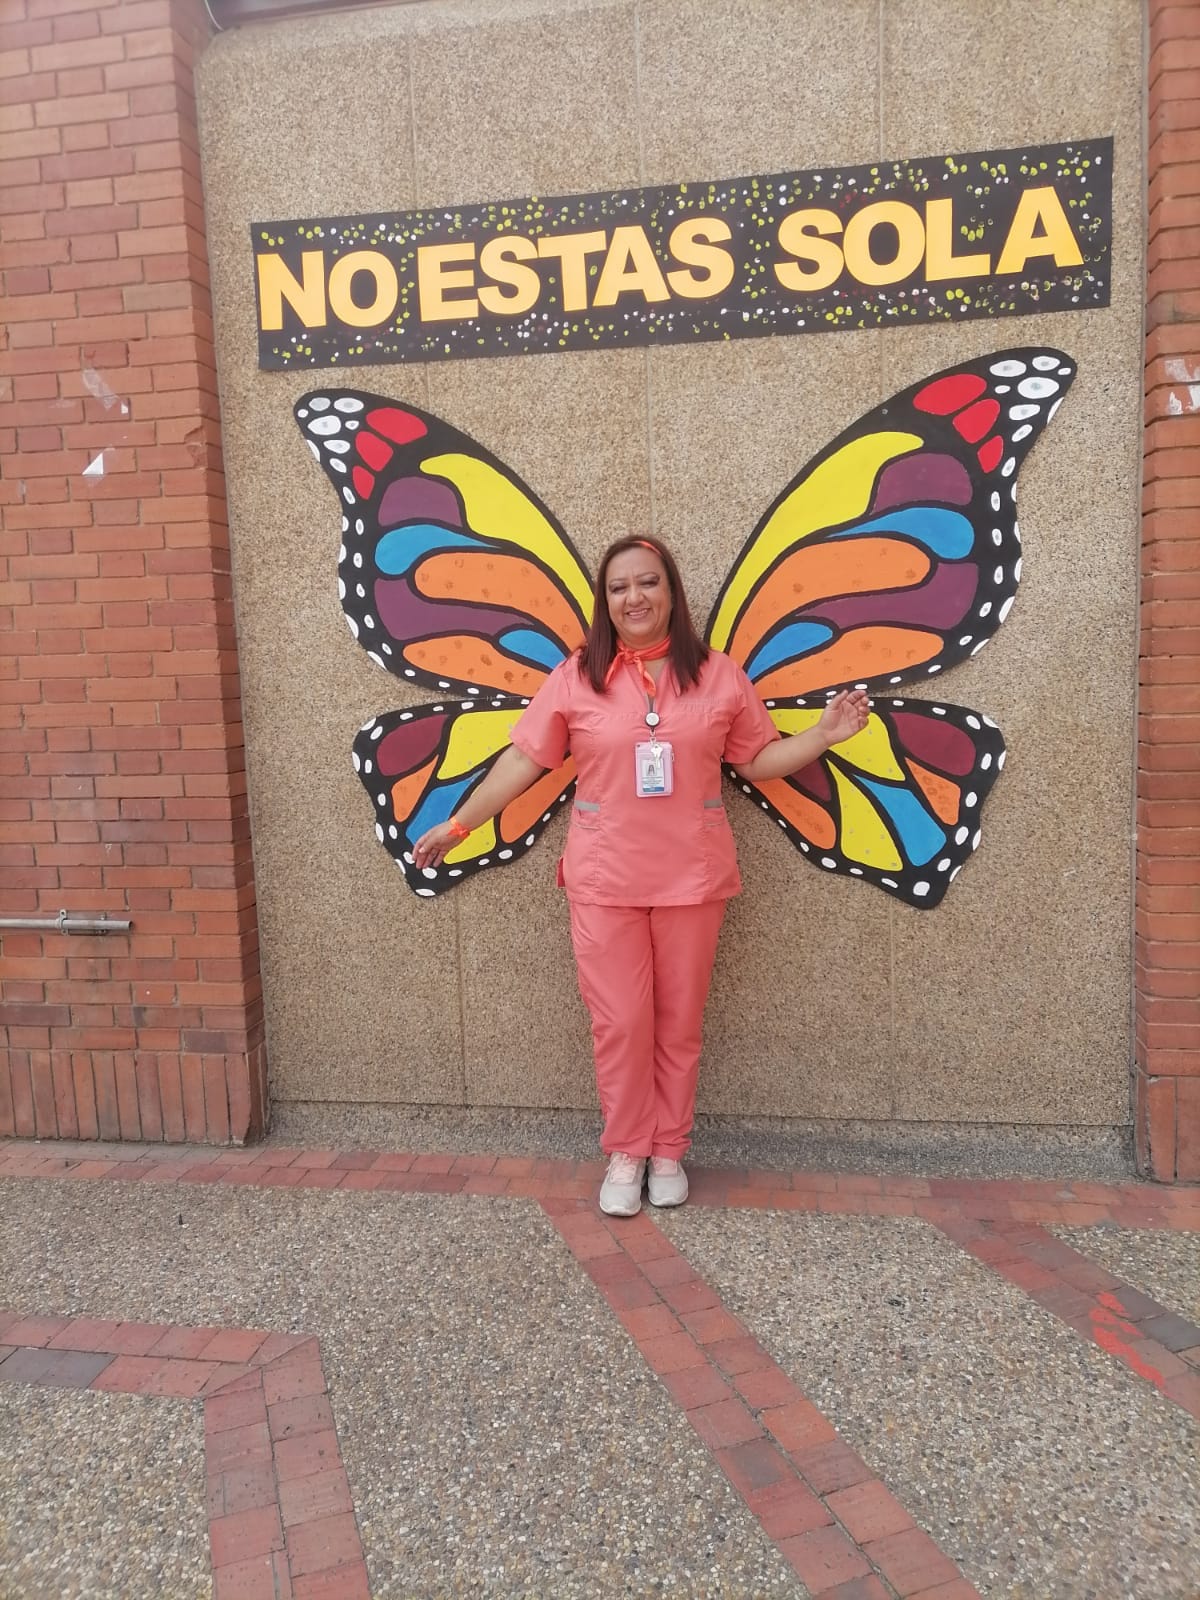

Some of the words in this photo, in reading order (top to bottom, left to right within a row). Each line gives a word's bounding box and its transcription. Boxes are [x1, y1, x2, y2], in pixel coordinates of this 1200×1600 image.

[257, 250, 399, 331] NO
[417, 217, 735, 323] ESTAS
[773, 186, 1085, 292] SOLA
